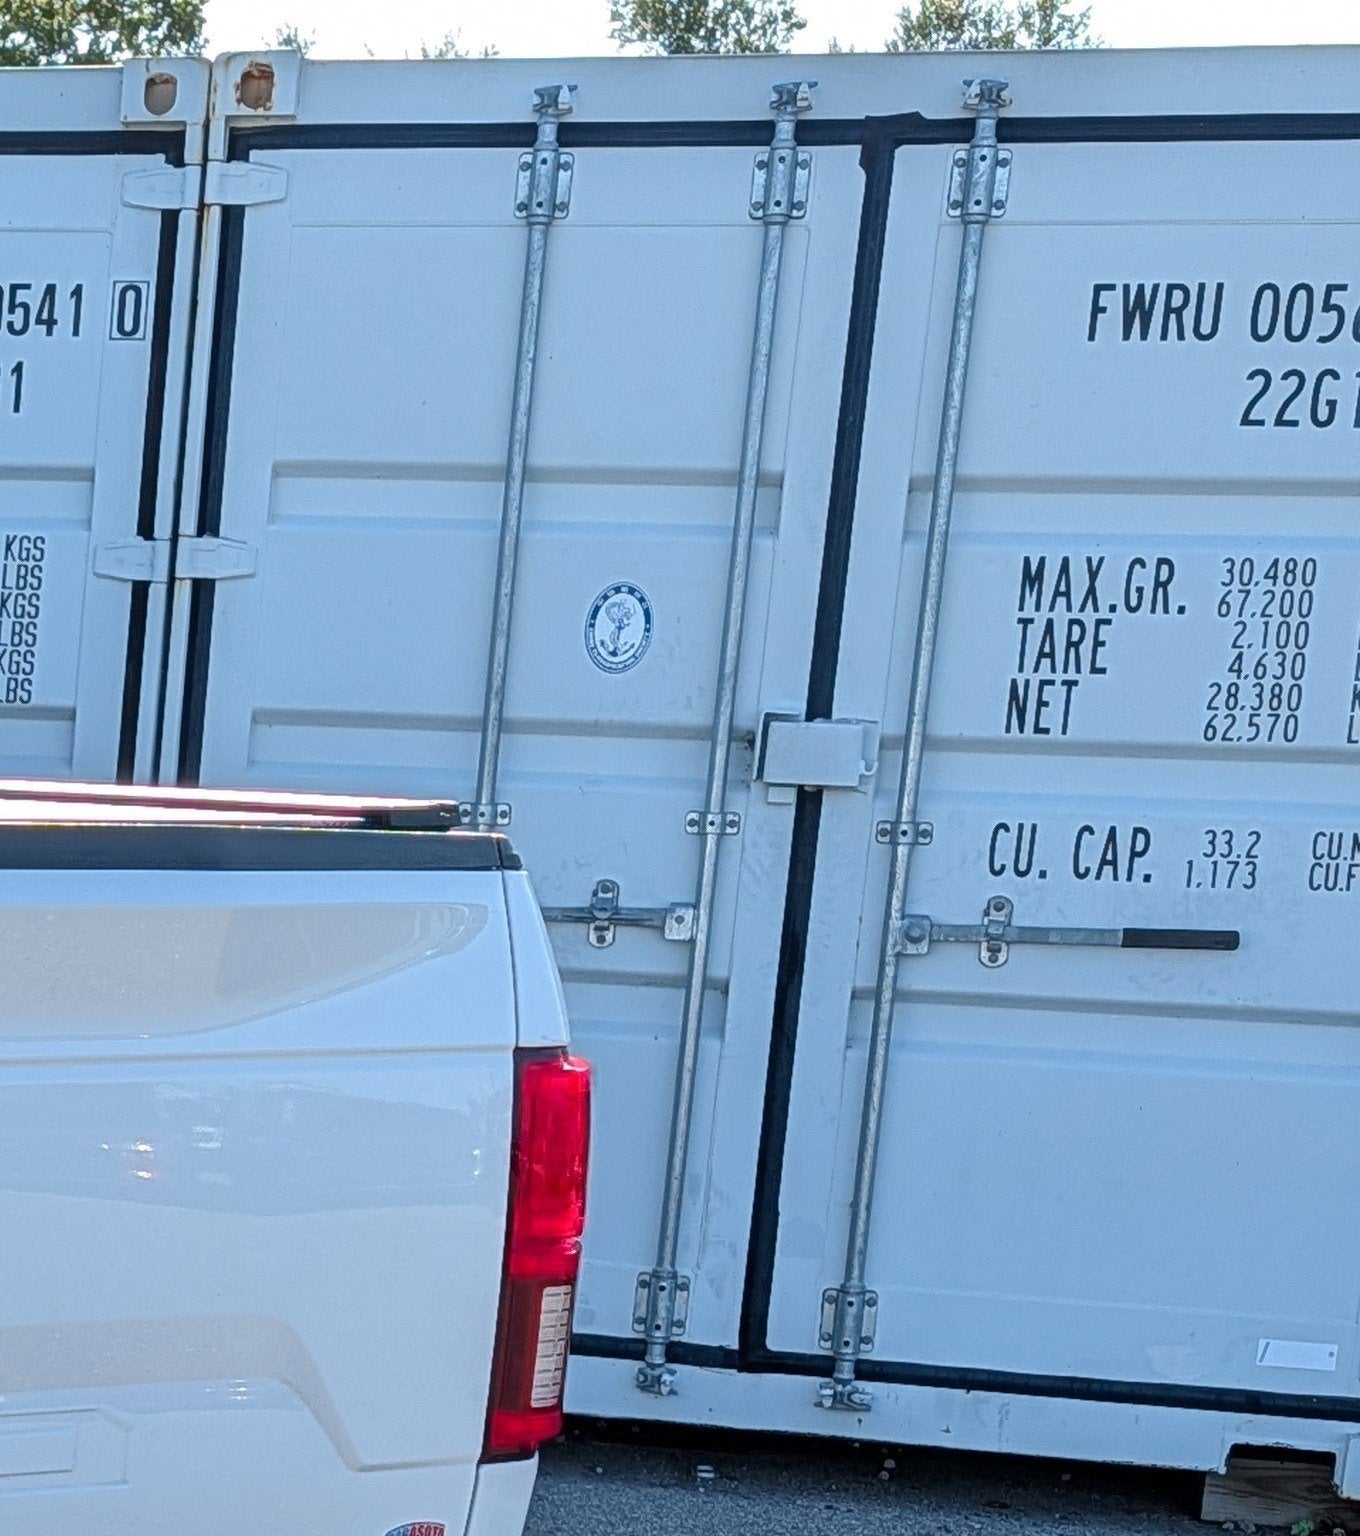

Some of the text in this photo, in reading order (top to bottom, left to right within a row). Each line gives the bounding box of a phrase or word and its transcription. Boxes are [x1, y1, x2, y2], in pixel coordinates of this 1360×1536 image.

[116, 284, 144, 337] 0
[1087, 281, 1360, 344] FWRU 005
[1, 563, 44, 592] LBS
[4, 534, 47, 563] KGS
[1017, 556, 1186, 615] MAX.GR.
[1016, 617, 1113, 675] TARE
[1004, 678, 1079, 736] NET
[987, 822, 1048, 880] CU.
[1072, 825, 1153, 884] CAP.
[1202, 829, 1262, 859] 33.2
